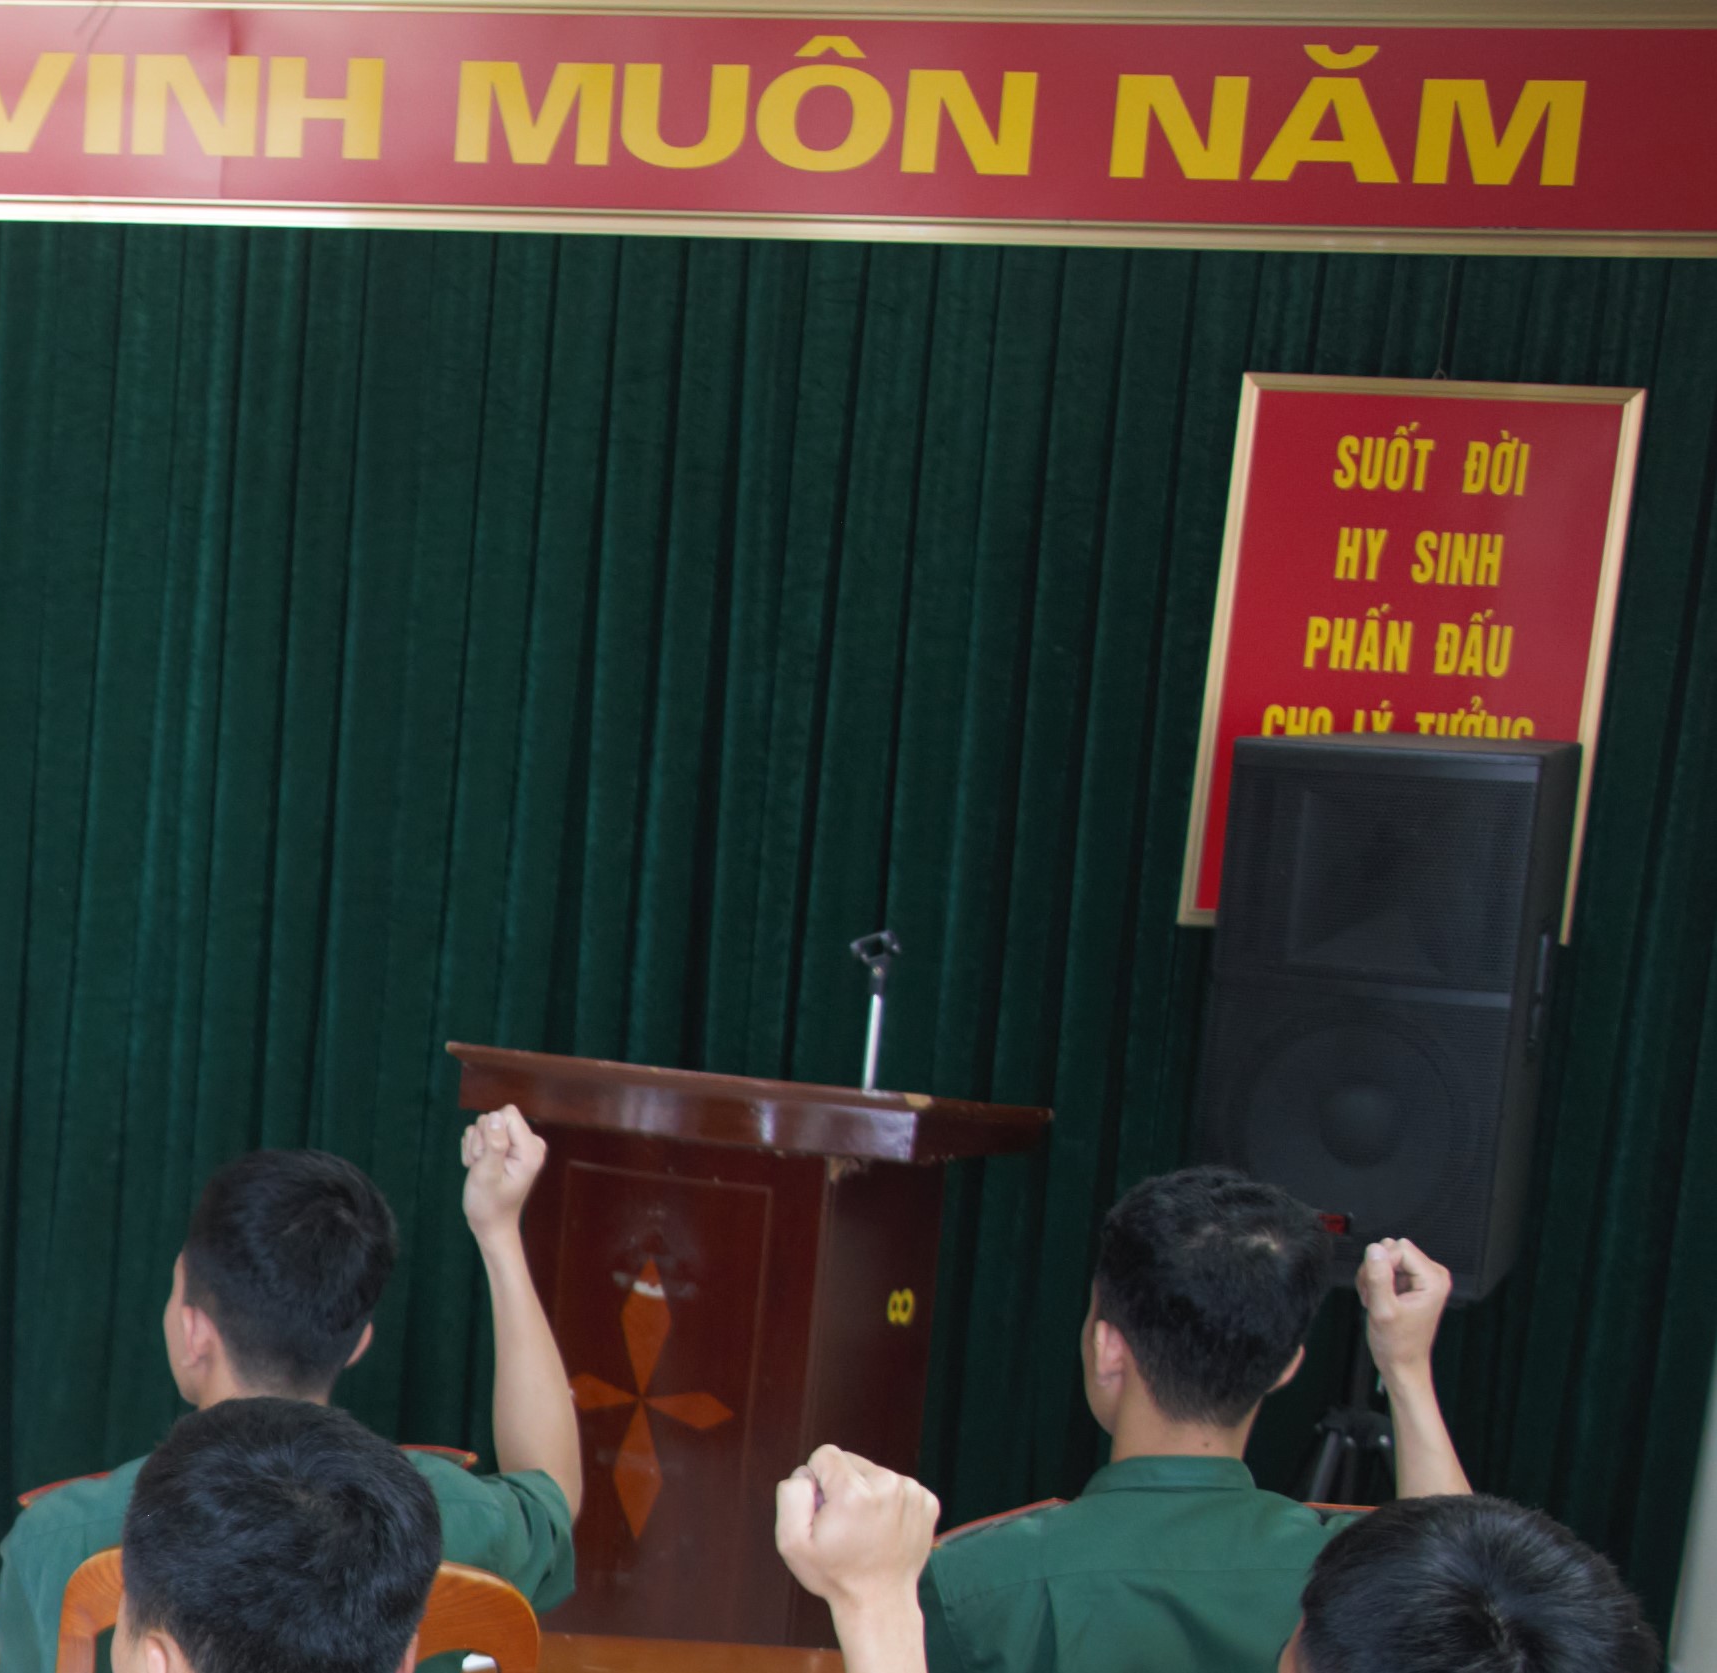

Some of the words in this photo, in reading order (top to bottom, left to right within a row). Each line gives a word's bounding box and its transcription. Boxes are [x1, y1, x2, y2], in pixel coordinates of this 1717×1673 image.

[454, 35, 1038, 177] MUÔN
[1108, 44, 1586, 187] NĂM
[1333, 421, 1434, 492] SUỐT
[1462, 429, 1530, 496] ĐỜI
[1334, 527, 1388, 581] HY
[1411, 531, 1504, 586] SINH
[1303, 603, 1413, 673] PHẤN
[1434, 608, 1514, 678] ĐẤU
